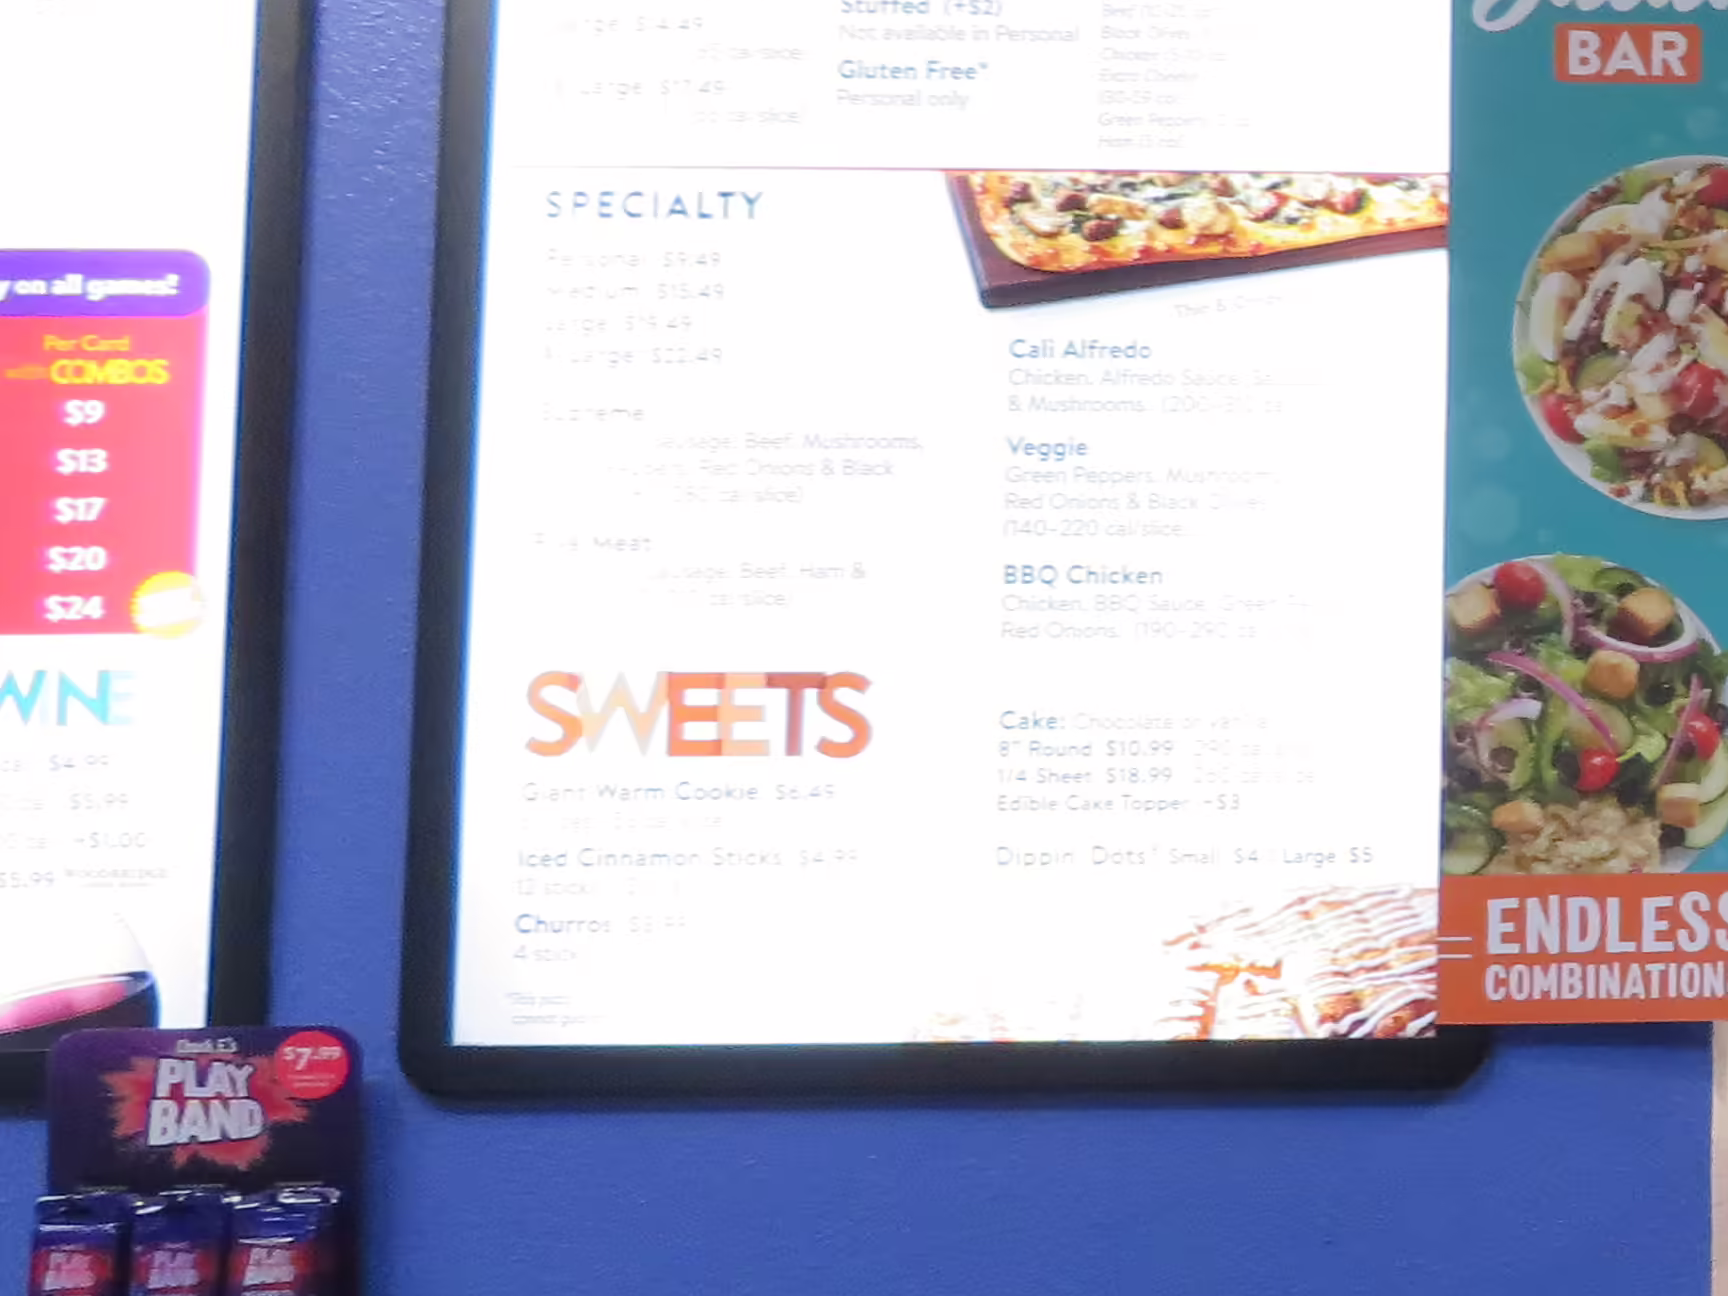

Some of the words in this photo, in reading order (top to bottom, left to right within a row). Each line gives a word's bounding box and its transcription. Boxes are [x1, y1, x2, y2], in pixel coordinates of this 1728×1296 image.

[997, 25, 1080, 43] Personal
[1566, 30, 1687, 78] BAR
[836, 59, 917, 81] Gluten
[835, 89, 922, 108] Personal
[546, 190, 764, 221] SPECIALTY
[1007, 337, 1056, 361] Cali
[1060, 337, 1154, 361] Alfredo
[49, 357, 172, 386] COMBOS
[1099, 368, 1177, 388] Alfredo
[63, 399, 106, 427] $9
[54, 447, 110, 476] $13
[1005, 436, 1091, 463] Veggie
[1003, 465, 1069, 484] Green
[54, 496, 108, 525] $17
[46, 545, 109, 573] $20
[1002, 564, 1058, 588] BBQ
[1065, 564, 1165, 587] Chicken
[44, 594, 106, 623] $24
[524, 668, 875, 759] SWEETS
[997, 710, 1067, 734] Cake:
[1028, 739, 1095, 759] Round
[1104, 738, 1176, 760] $10.99
[996, 766, 1029, 786] 1/4
[1035, 766, 1094, 786] Sheet
[1105, 765, 1174, 787] $18.99
[596, 781, 667, 801] Warm
[673, 780, 761, 803] Cookie
[996, 792, 1059, 813] Edible
[1064, 792, 1115, 813] Cake
[1118, 792, 1191, 817] Topper
[516, 848, 569, 869] Iced
[575, 847, 703, 869] Cinnamon
[710, 847, 784, 869] Sticks
[1232, 846, 1260, 868] $4
[1282, 846, 1337, 871] Large
[1349, 846, 1375, 868] $5
[513, 912, 611, 935] Churros
[283, 1044, 343, 1071] $7.99
[156, 1056, 254, 1100] PLAY
[146, 1097, 267, 1147] BAND
